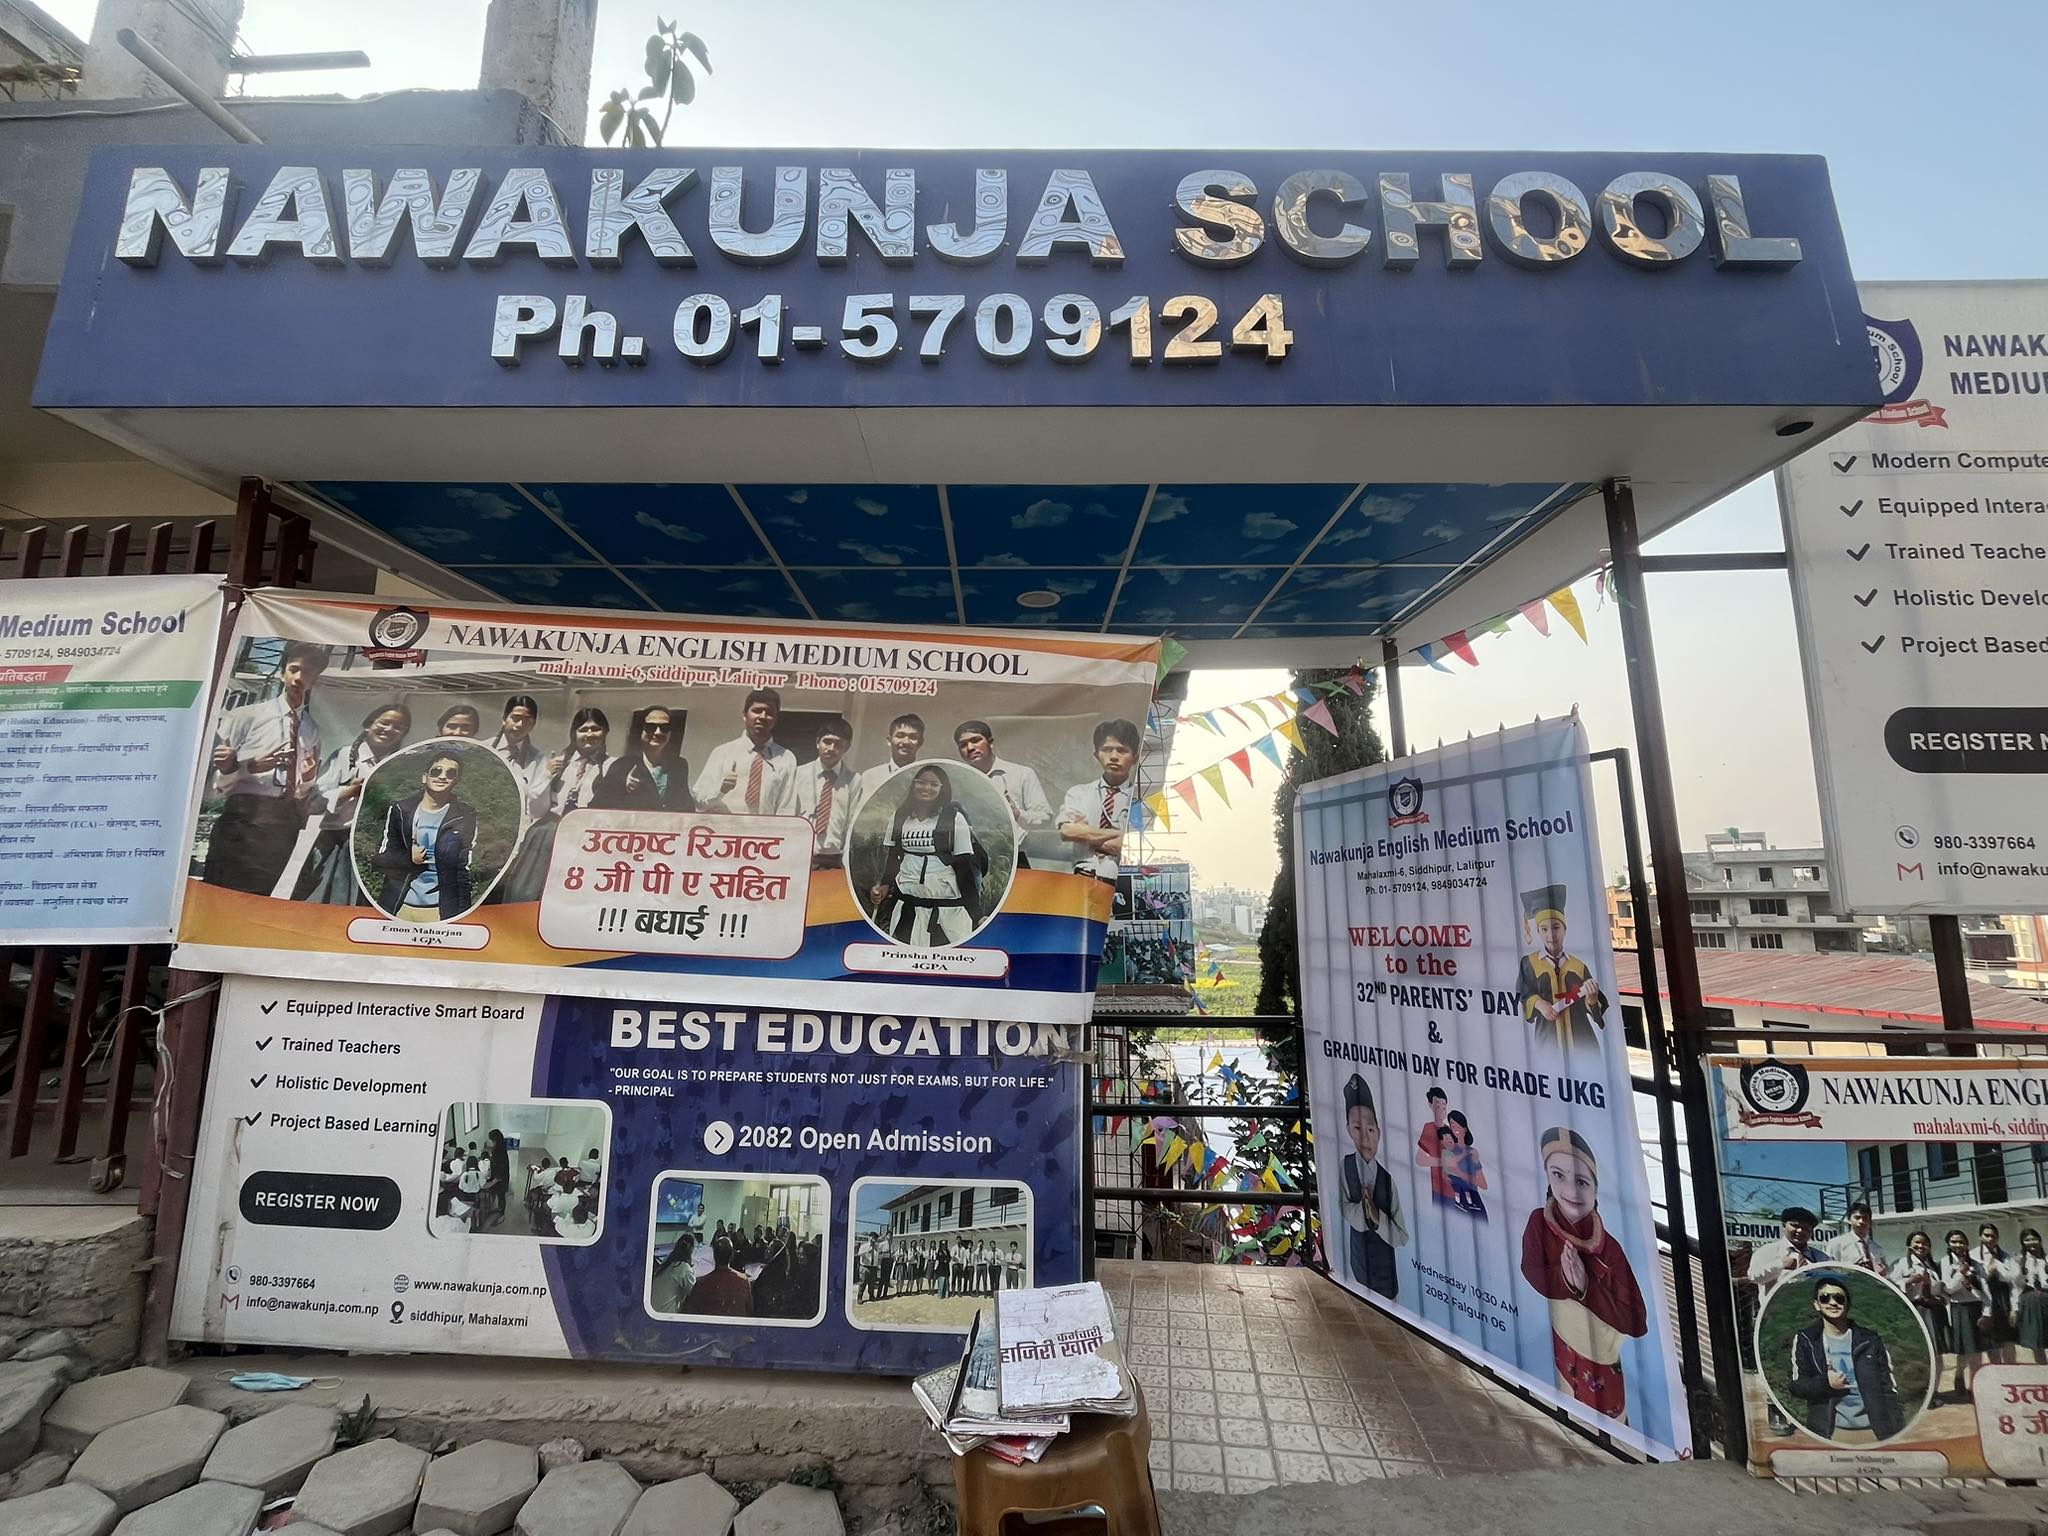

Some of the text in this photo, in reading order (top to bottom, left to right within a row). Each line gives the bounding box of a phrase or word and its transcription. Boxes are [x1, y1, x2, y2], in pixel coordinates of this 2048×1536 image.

[115, 166, 1803, 270] NAWAKUNJA SCHOOL
[491, 294, 649, 366] Ph.
[1871, 452, 1951, 469] Modern
[1878, 497, 2048, 517] Equipped Intera
[1884, 543, 1965, 560] Trained
[1893, 589, 1975, 606] Holistic
[0, 609, 187, 638] Medium School
[5, 645, 122, 660] 5709124, 9849034724
[446, 624, 631, 655] NAWAKUNJA
[637, 634, 767, 663] ENGLISH
[774, 641, 900, 670] MEDIUM
[906, 648, 1030, 676] SCHOOL
[1901, 636, 2048, 658] Project Based
[538, 659, 646, 683] mahalaxmi-6,
[648, 665, 718, 688] siddipur,
[720, 668, 787, 689] Lalitpur
[860, 675, 938, 696] 015709124
[1909, 732, 2034, 751] REGISTER
[581, 826, 785, 862] उत्कृष्ट रिजल्ट
[1309, 809, 1574, 866] Nawakunja English Medium School
[1933, 835, 2036, 850] 980-3397664
[593, 860, 635, 893] जी
[642, 862, 674, 895] पी
[681, 872, 703, 897] ए
[709, 865, 790, 901] सहित
[1356, 858, 1496, 881] Mahalaxmi-6, Siddhipur, Lalitpur
[1365, 886, 1377, 896] Ph.
[1431, 876, 1488, 891] 9849034724
[382, 925, 462, 937] Emon Maharjan
[634, 904, 710, 941] बधाई
[1348, 924, 1473, 948] WELCOME
[881, 951, 977, 964] Prinsha Pandey
[1385, 952, 1458, 977] to the
[286, 999, 525, 1020] Equipped Interactive Smart Board
[1481, 990, 1521, 1017] DAY
[610, 1009, 1071, 1057] BEST EDUCATION
[1427, 1020, 1444, 1044] &
[281, 1037, 401, 1055] Trained Teachers
[275, 1074, 428, 1096] Holistic Development
[642, 1068, 675, 1080] GOAL
[677, 1069, 688, 1081] IS
[691, 1070, 707, 1081] TO
[709, 1071, 763, 1082] PREPARE
[766, 1071, 828, 1084] STUDENTS
[830, 1073, 855, 1084] NOT
[857, 1074, 888, 1085] JUST
[890, 1075, 915, 1086] FOR
[917, 1075, 962, 1088] EXAMS,
[965, 1076, 989, 1087] BUT
[992, 1076, 1017, 1087] FOR
[1323, 1039, 1607, 1109] GRADUATION DAY FOR GRADE UKG
[615, 1085, 675, 1097] PRINCIPAL
[1822, 1077, 1984, 1106] NAWAKUNJA
[270, 1113, 438, 1137] Project Based Learning
[1913, 1117, 2006, 1138] mahalaxmi-6,
[738, 1126, 992, 1154] 2082 Open Admission
[255, 1191, 380, 1213] REGISTER NOW
[249, 1275, 316, 1290] 980-3397664
[413, 1279, 548, 1298] www.nawakunja.com.np
[1411, 1258, 1467, 1294] Wednesday
[1500, 1300, 1519, 1318] AM
[246, 1296, 380, 1317] info@nawakunja.com.np
[1424, 1284, 1507, 1332] 2082 Falgun 06
[409, 1310, 529, 1328] siddhipur, Mahalaxmi
